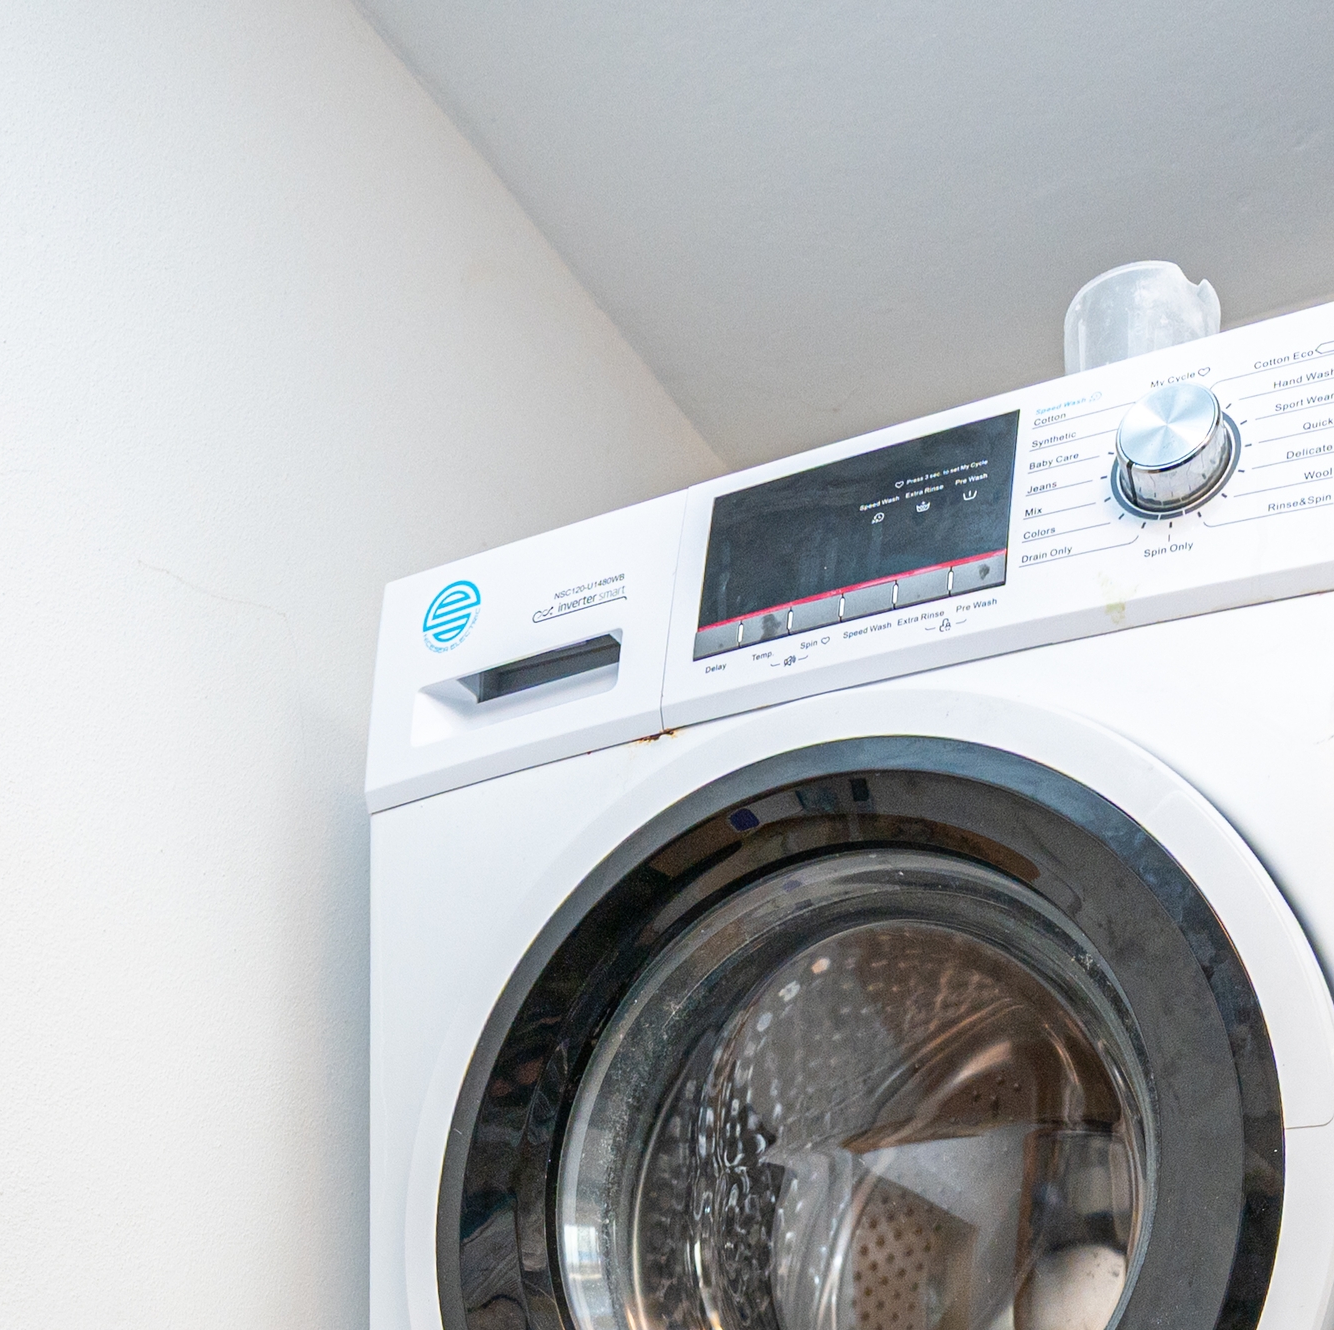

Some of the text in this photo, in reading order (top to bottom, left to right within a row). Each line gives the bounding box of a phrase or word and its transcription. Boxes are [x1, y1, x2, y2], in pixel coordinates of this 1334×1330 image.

[1253, 350, 1314, 369] Cotton Eco
[1168, 372, 1195, 384] Cycle
[1273, 375, 1303, 388] Hand
[1275, 393, 1334, 412] Sport Wear
[1033, 413, 1067, 426] Cotton
[1302, 417, 1334, 430] Quick
[1031, 432, 1077, 448] Synthetic
[1286, 444, 1333, 459] Delicate
[1029, 453, 1079, 470] Baby Care
[1303, 467, 1333, 480] Wool
[1027, 481, 1057, 494] Jeans
[1267, 493, 1332, 512] Rinse&Spin
[1024, 507, 1042, 517] Mix
[1023, 527, 1056, 540] Colors
[1021, 546, 1073, 563] Drain Only
[1143, 541, 1194, 558] Spin Only
[557, 585, 626, 612] inverter smart
[955, 598, 998, 613] Pre Wash
[897, 610, 945, 626] Extra Rinse
[843, 621, 892, 639] Speed Wash
[800, 639, 818, 650] Spin
[751, 651, 774, 662] Temp.
[705, 663, 727, 674] Delay
